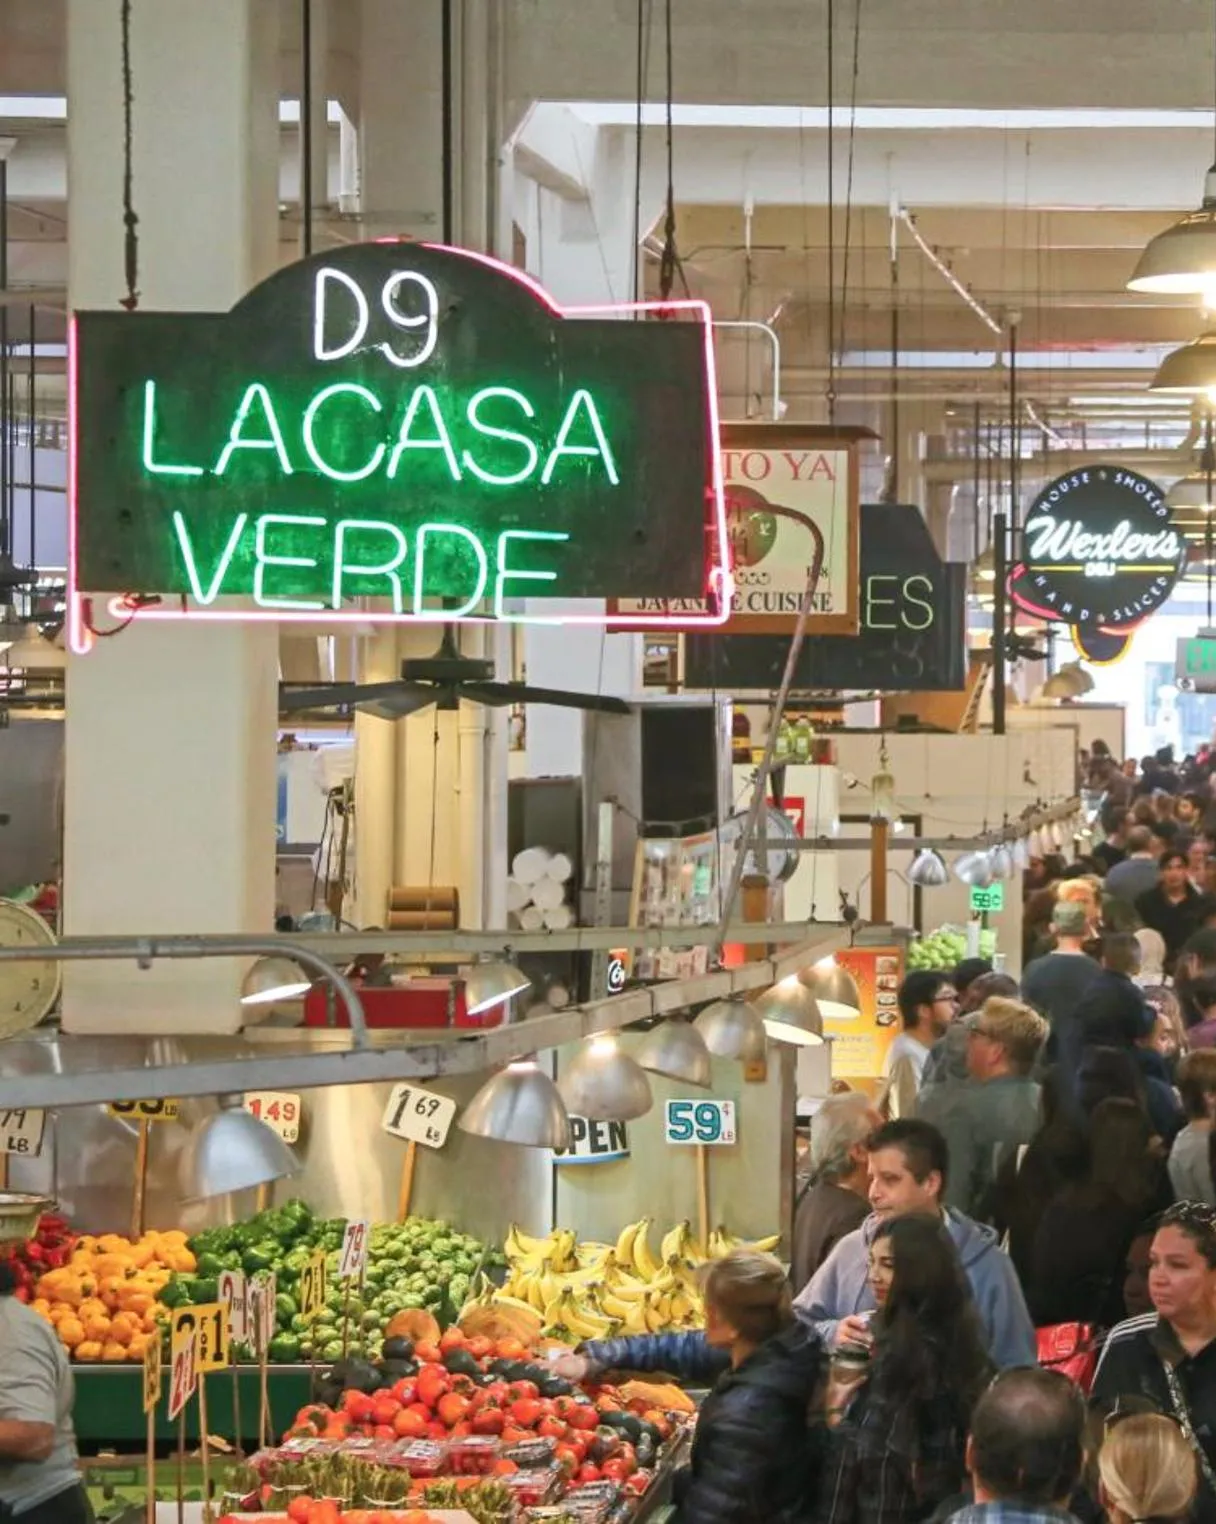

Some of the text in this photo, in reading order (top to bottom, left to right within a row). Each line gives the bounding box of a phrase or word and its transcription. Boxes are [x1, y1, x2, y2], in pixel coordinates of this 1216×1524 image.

[315, 268, 438, 367] D9
[1039, 472, 1168, 517] HOUSE SMOKED
[174, 512, 568, 623] VERDE
[1035, 575, 1168, 620] HAND SLICED
[553, 1117, 627, 1155] PEN
[668, 1102, 721, 1141] 59
[7, 1136, 29, 1153] LB
